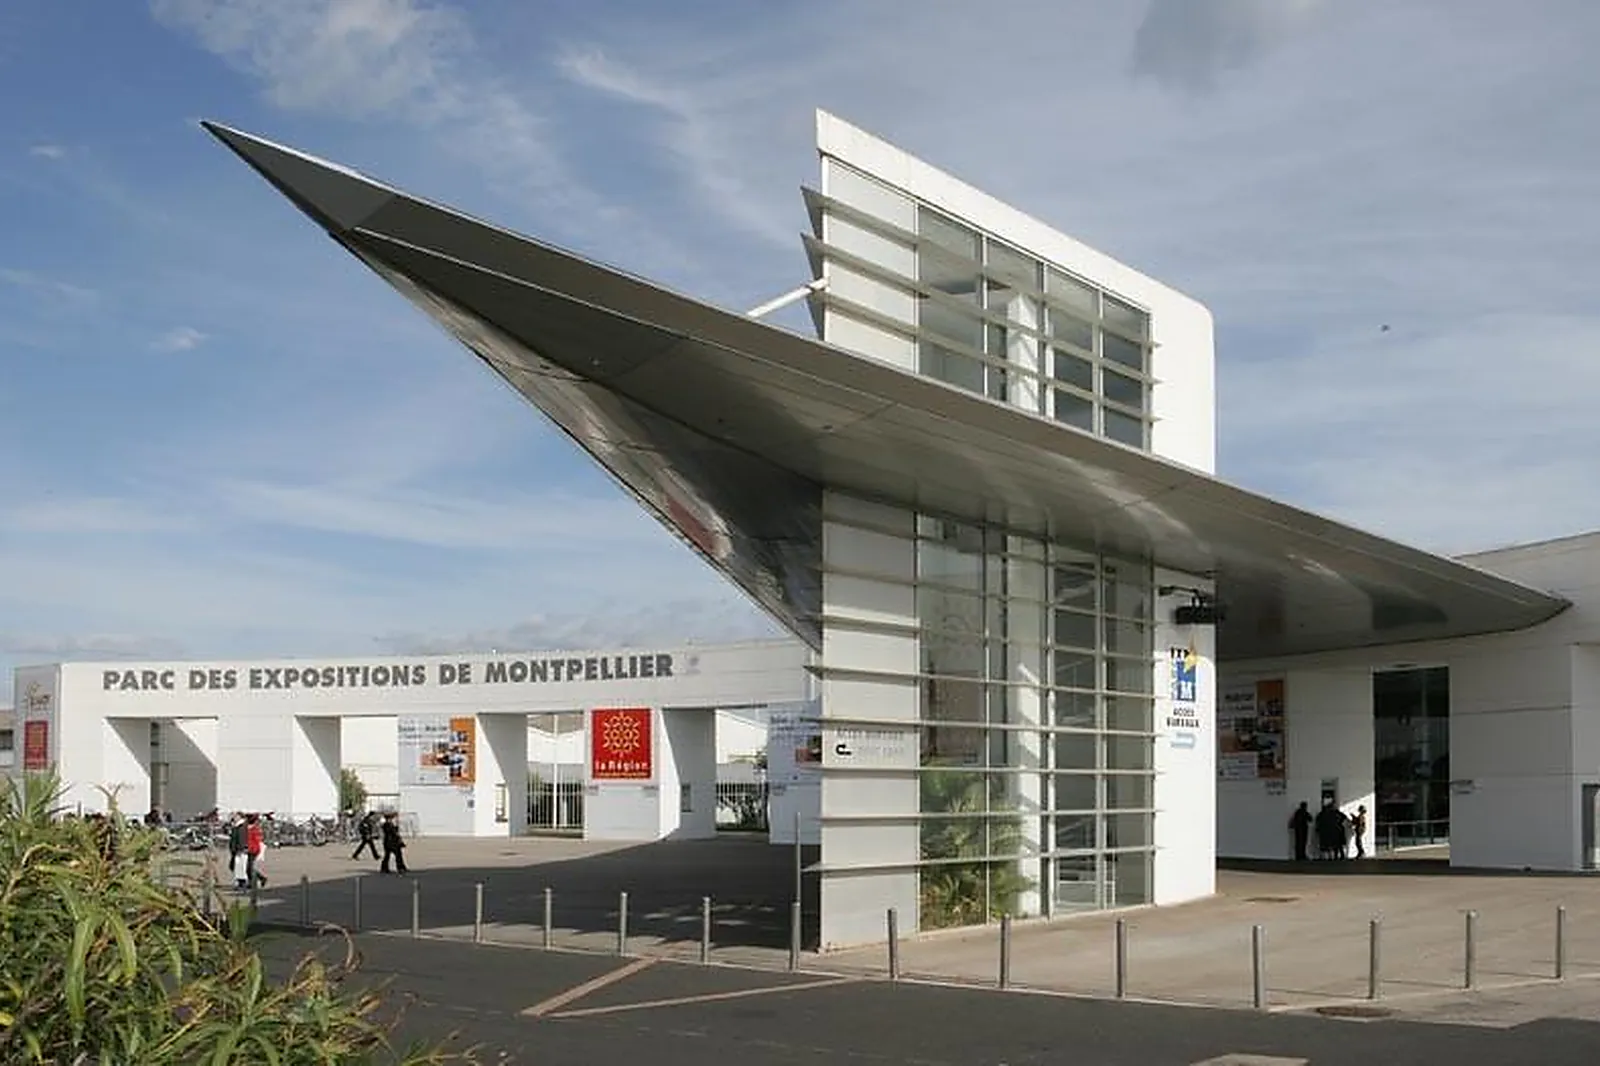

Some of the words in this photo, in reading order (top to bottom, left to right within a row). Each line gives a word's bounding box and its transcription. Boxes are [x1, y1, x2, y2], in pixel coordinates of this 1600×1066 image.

[103, 670, 175, 690] PARC
[188, 669, 237, 690] DES
[249, 664, 426, 689] EXPOSITIONS
[439, 663, 472, 686] DE
[485, 653, 674, 684] MONTPELLIER
